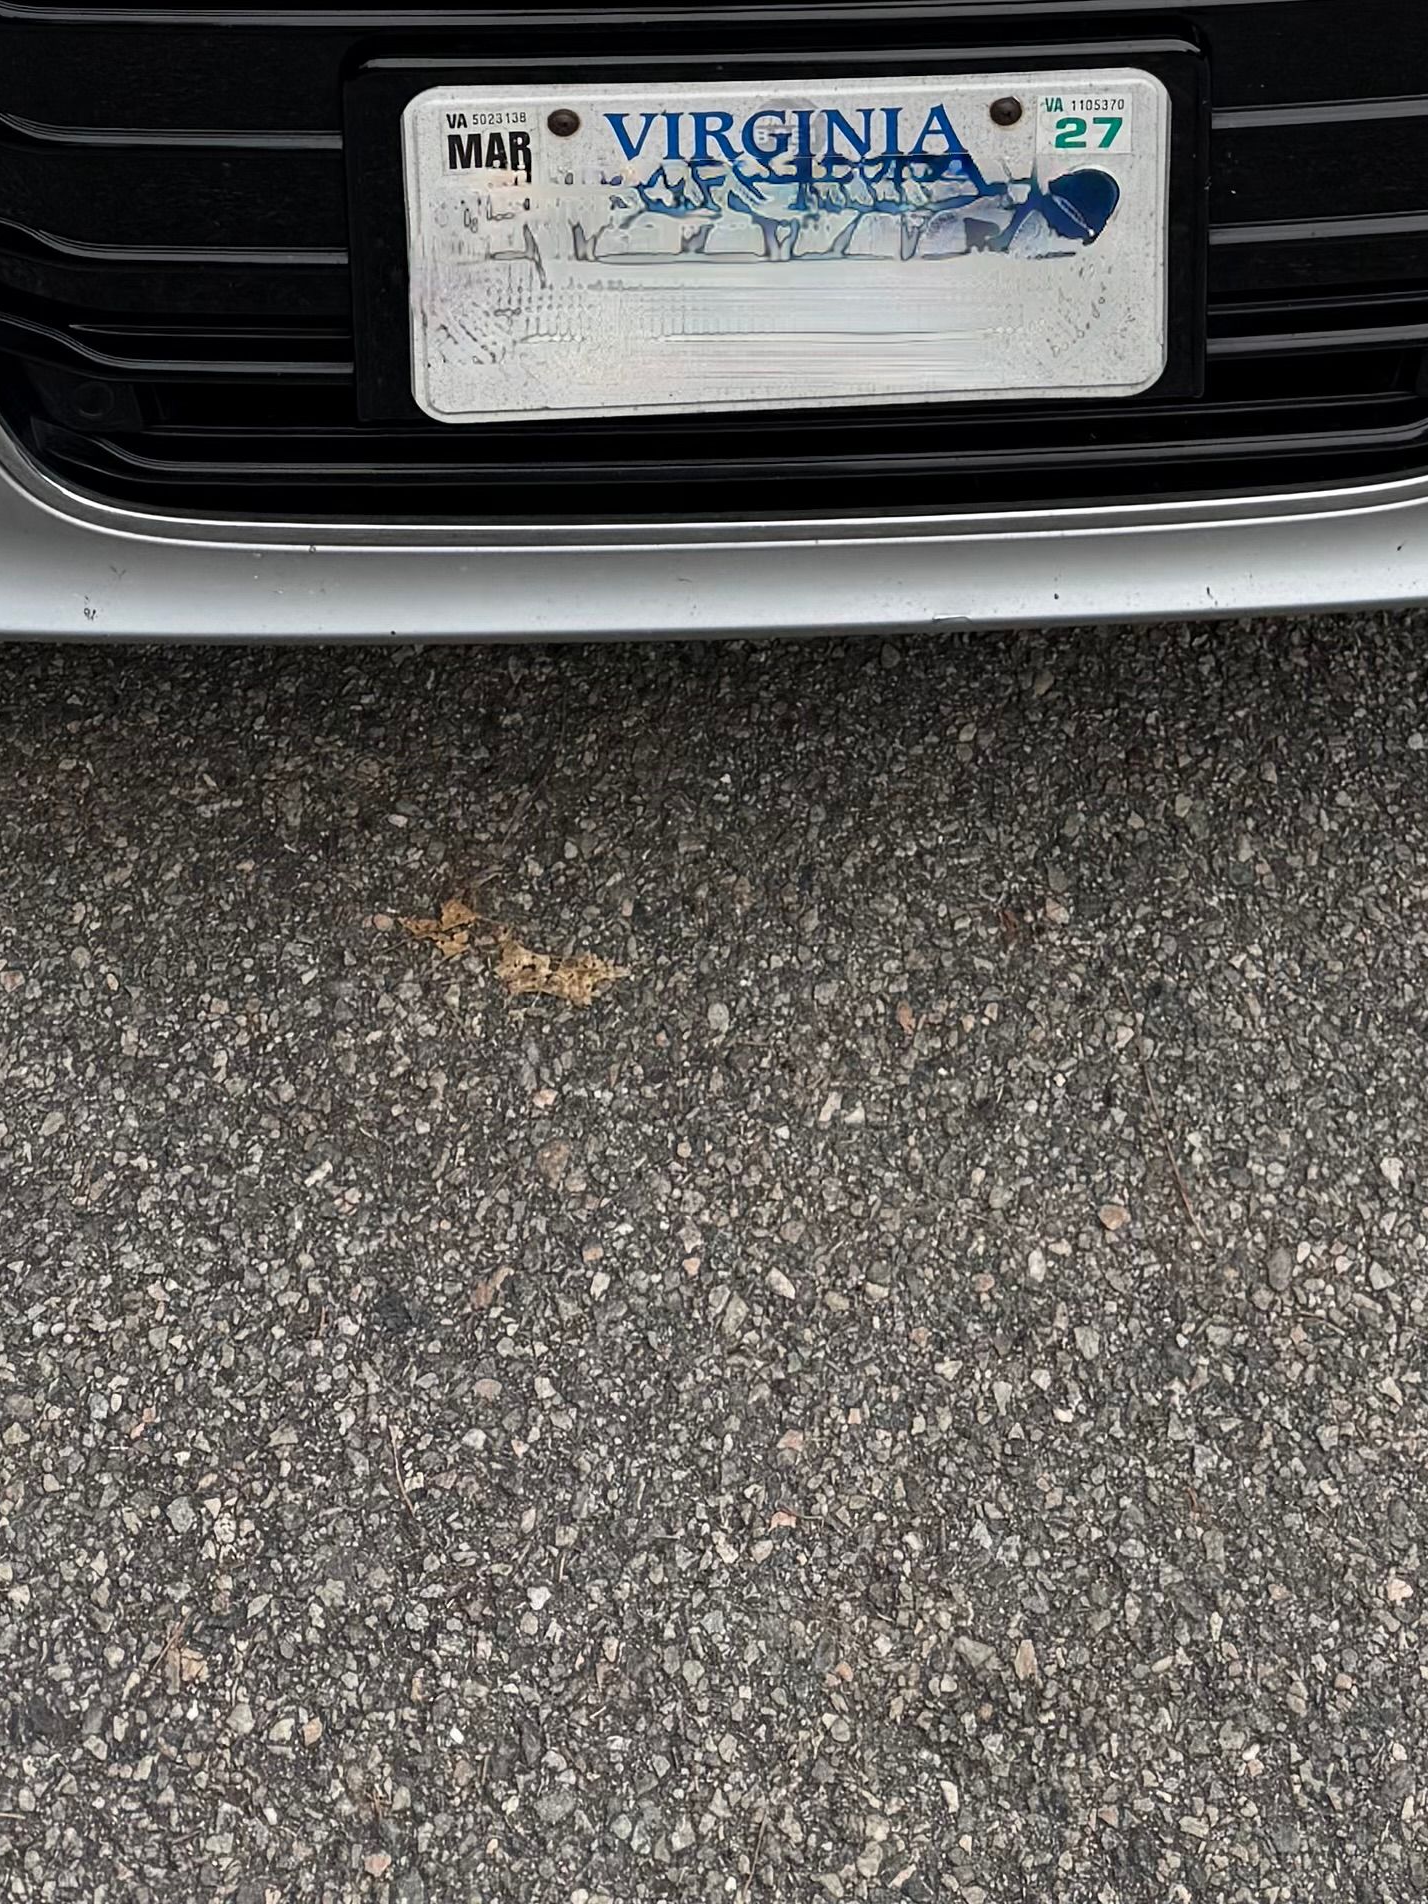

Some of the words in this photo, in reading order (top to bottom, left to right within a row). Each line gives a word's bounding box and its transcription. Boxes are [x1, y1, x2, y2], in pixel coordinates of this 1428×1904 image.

[446, 113, 468, 129] VA
[1045, 97, 1064, 113] VA
[1071, 98, 1125, 111] 1105370
[603, 103, 970, 161] VIRGINIA
[1054, 116, 1124, 149] 27
[447, 130, 532, 171] MAR
